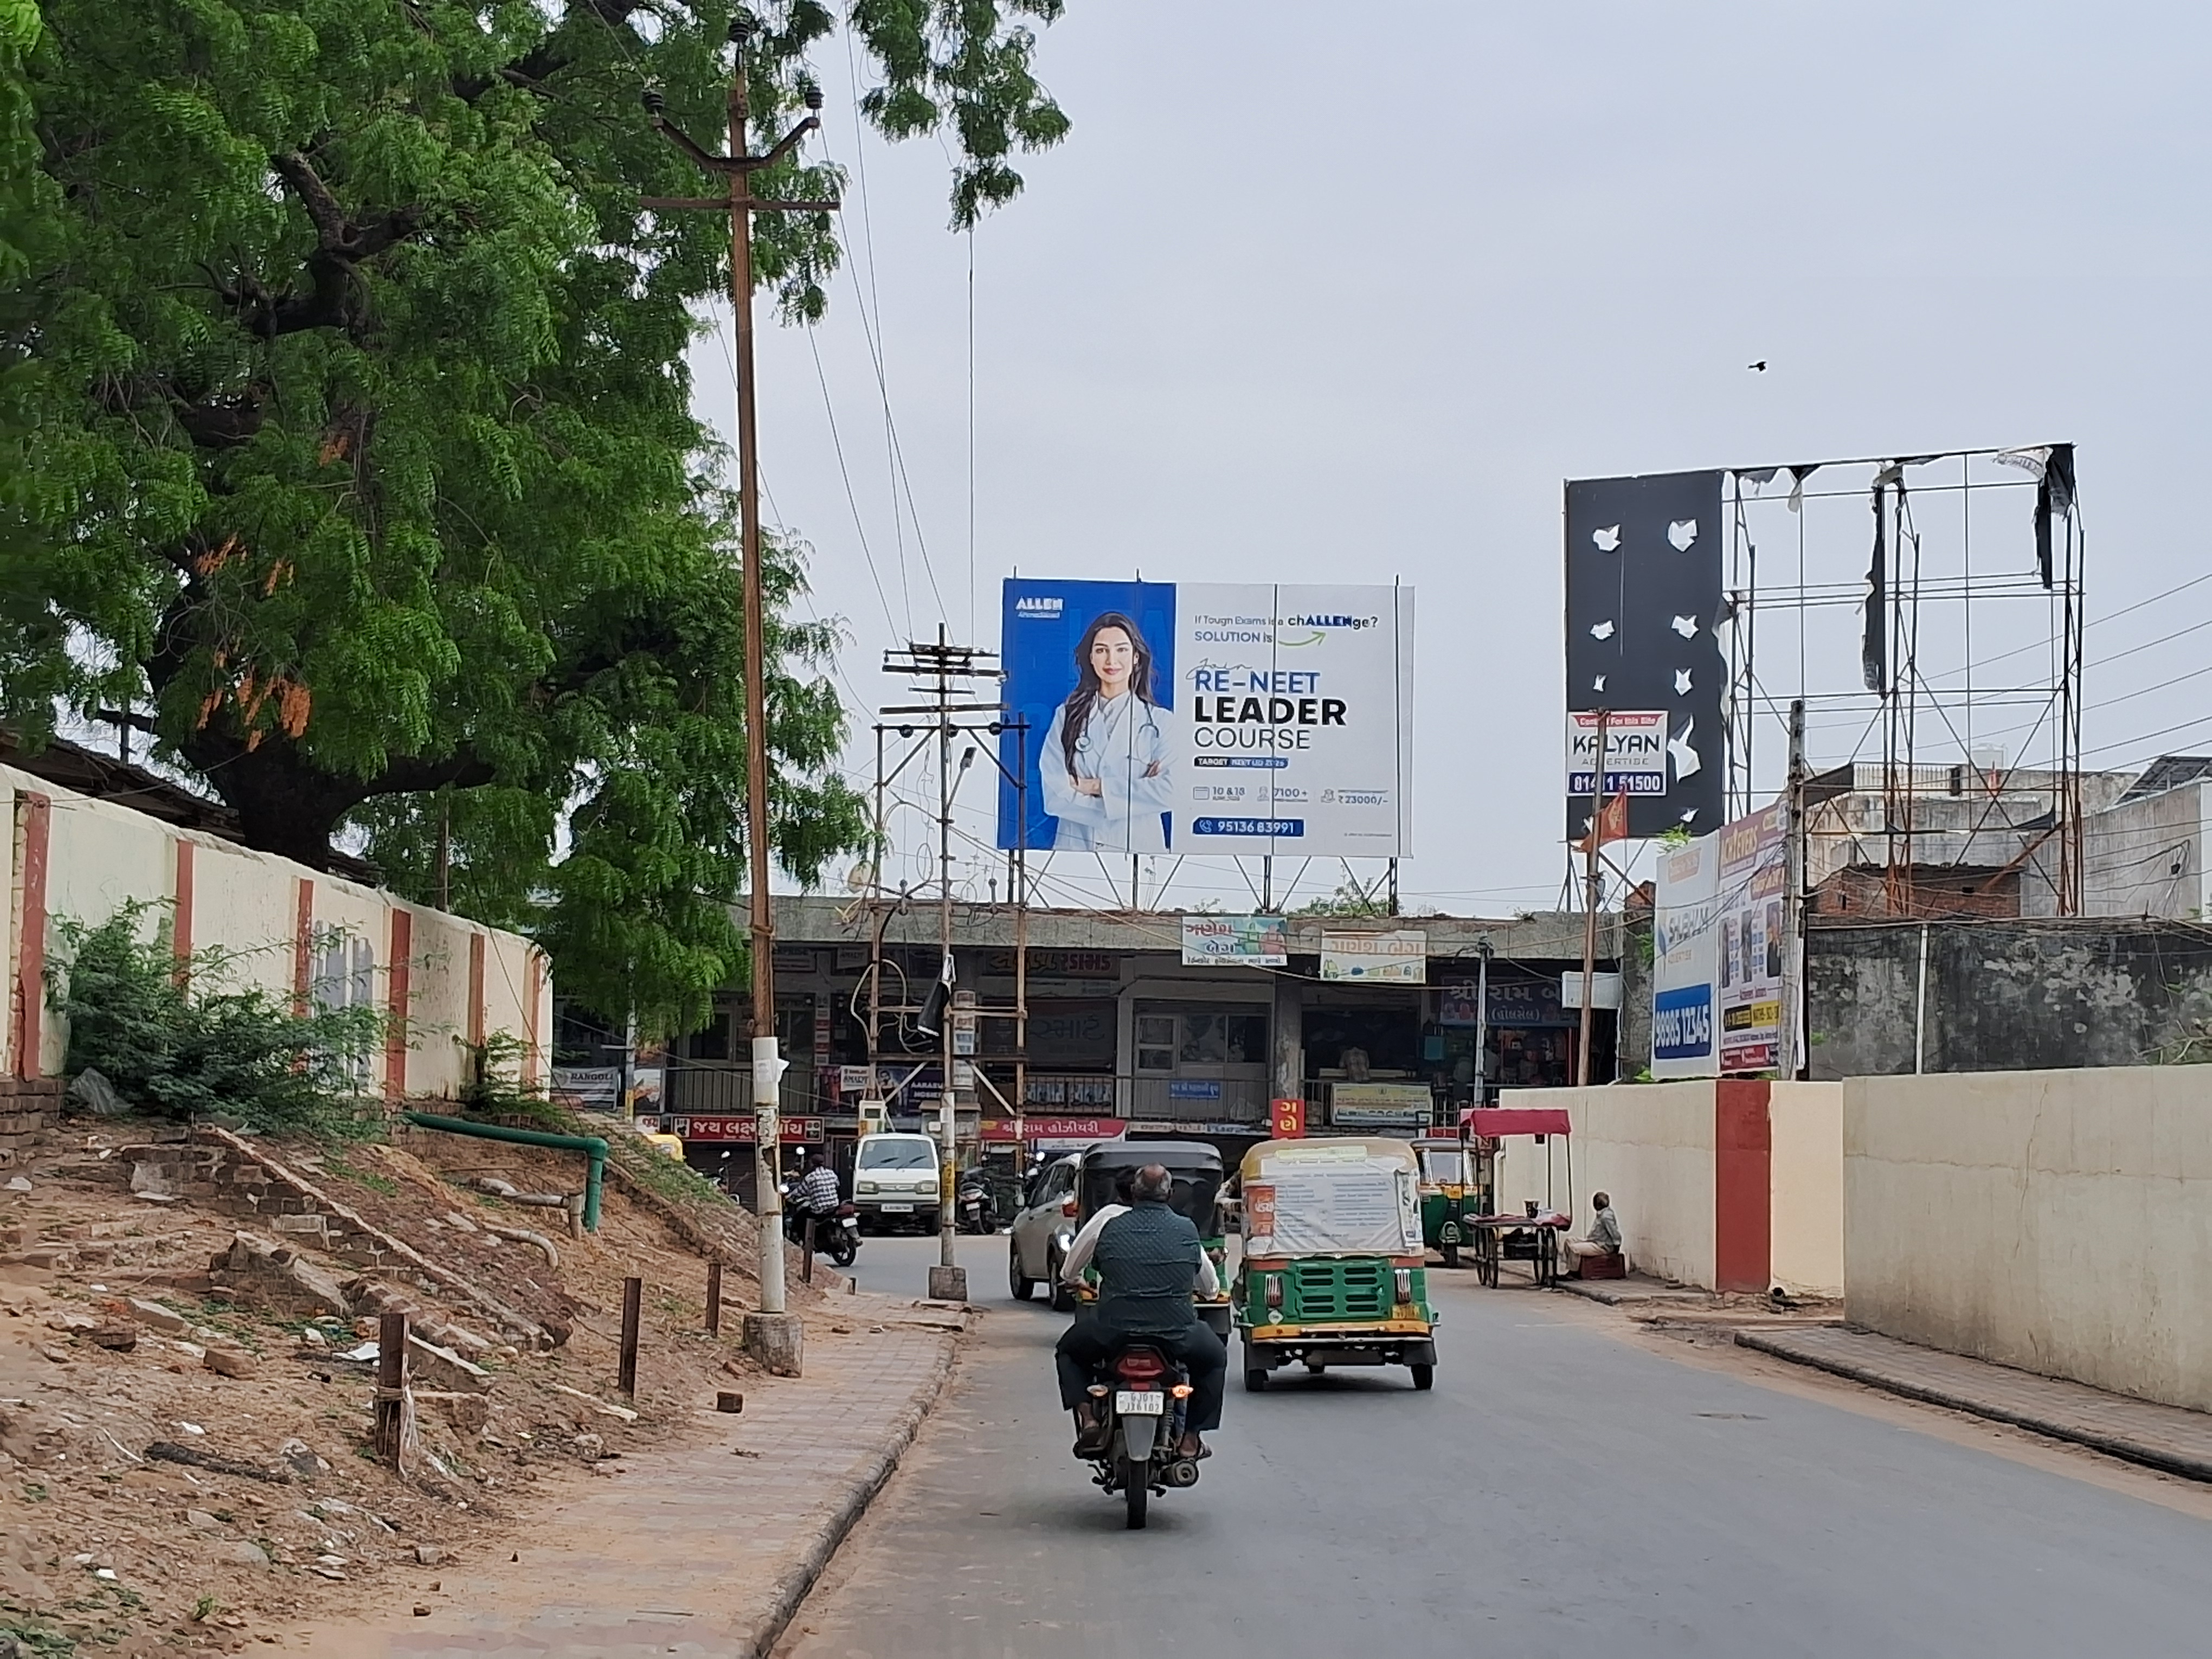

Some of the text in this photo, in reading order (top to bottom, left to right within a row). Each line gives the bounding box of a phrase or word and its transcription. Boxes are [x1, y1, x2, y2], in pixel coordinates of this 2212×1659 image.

[1015, 596, 1063, 611] ALLEN
[1195, 615, 1202, 624] If
[1203, 615, 1233, 626] Tough
[1235, 616, 1266, 625] Exams
[1195, 631, 1273, 642] SOLUTION is
[1195, 671, 1320, 693] RE-NEET
[1195, 696, 1347, 726] LEADER
[1194, 727, 1311, 749] COURSE
[1573, 734, 1660, 754] KALYAN
[1488, 985, 1533, 1001] રામ
[693, 1121, 720, 1133] જય
[1024, 1123, 1044, 1133] રામ
